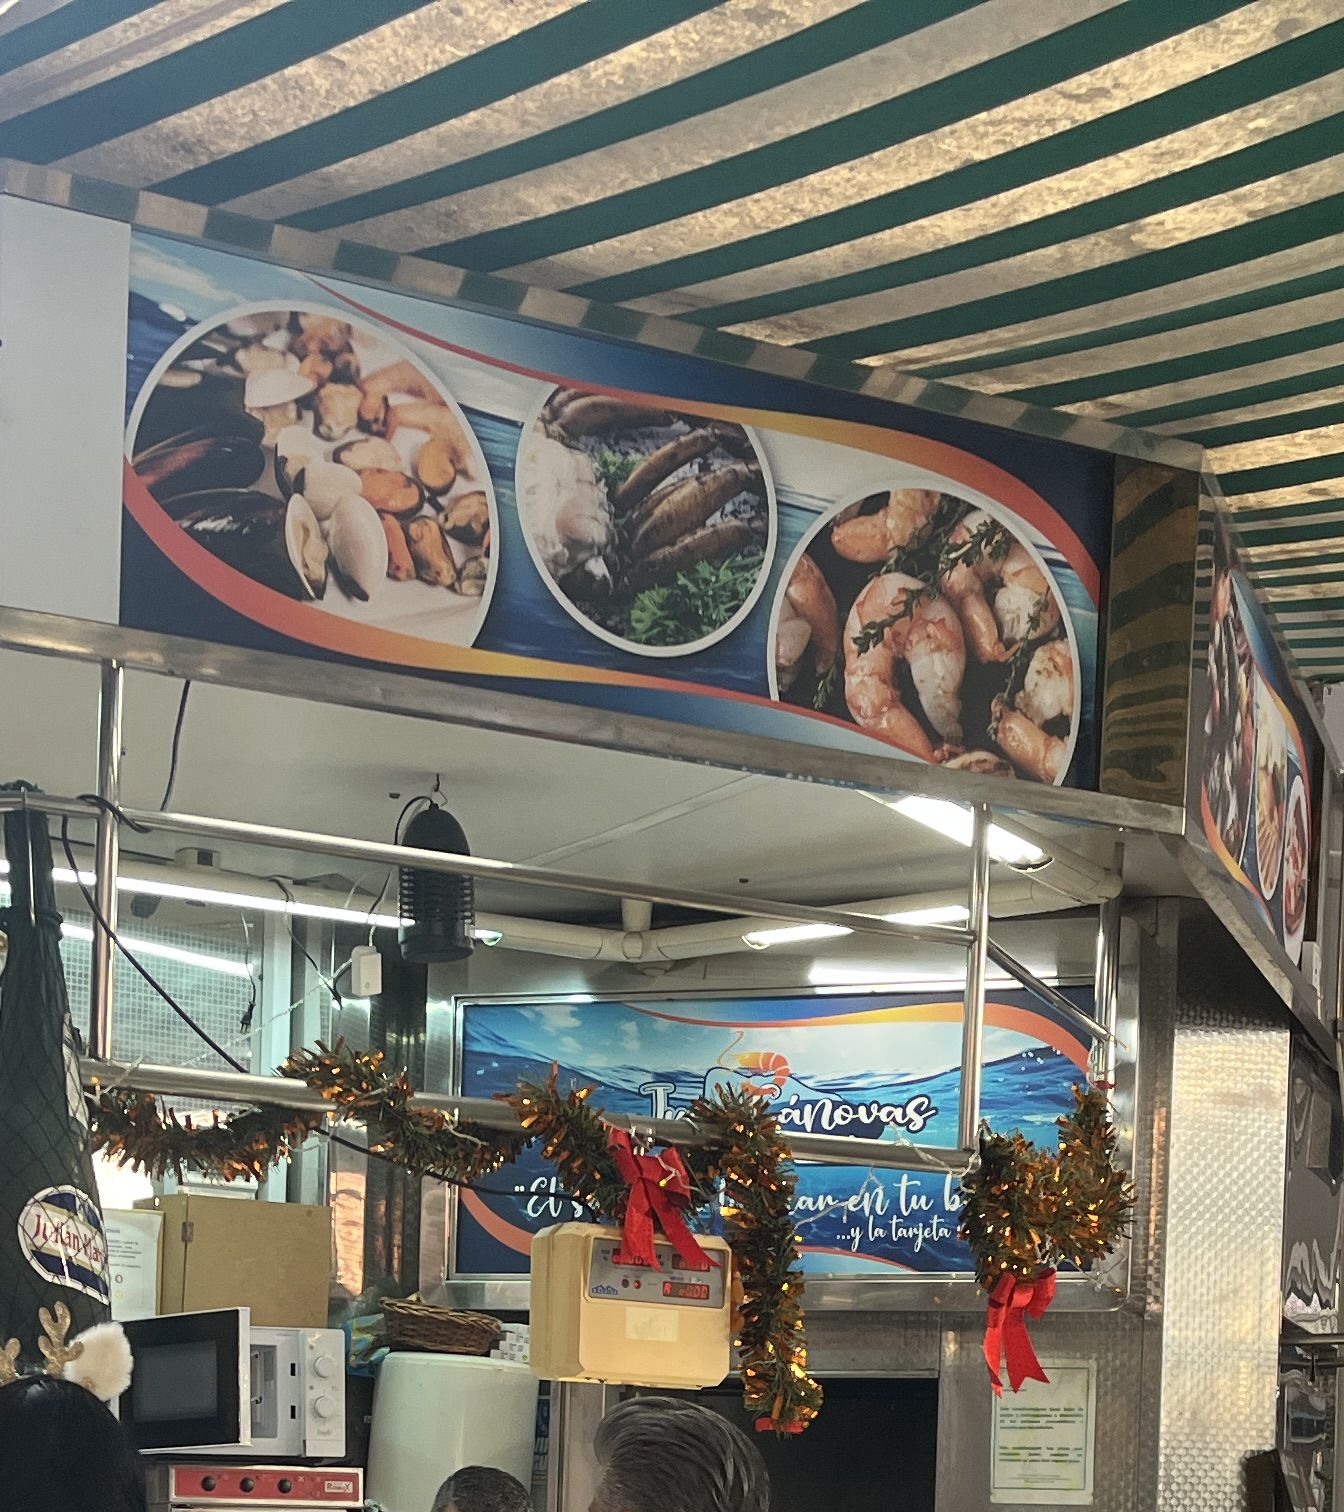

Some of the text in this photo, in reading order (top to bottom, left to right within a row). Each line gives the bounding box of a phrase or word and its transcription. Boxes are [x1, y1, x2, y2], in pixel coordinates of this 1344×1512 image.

[846, 1184, 890, 1216] en
[892, 1173, 934, 1214] tu
[867, 1215, 887, 1241] la
[888, 1214, 951, 1253] tarjeta
